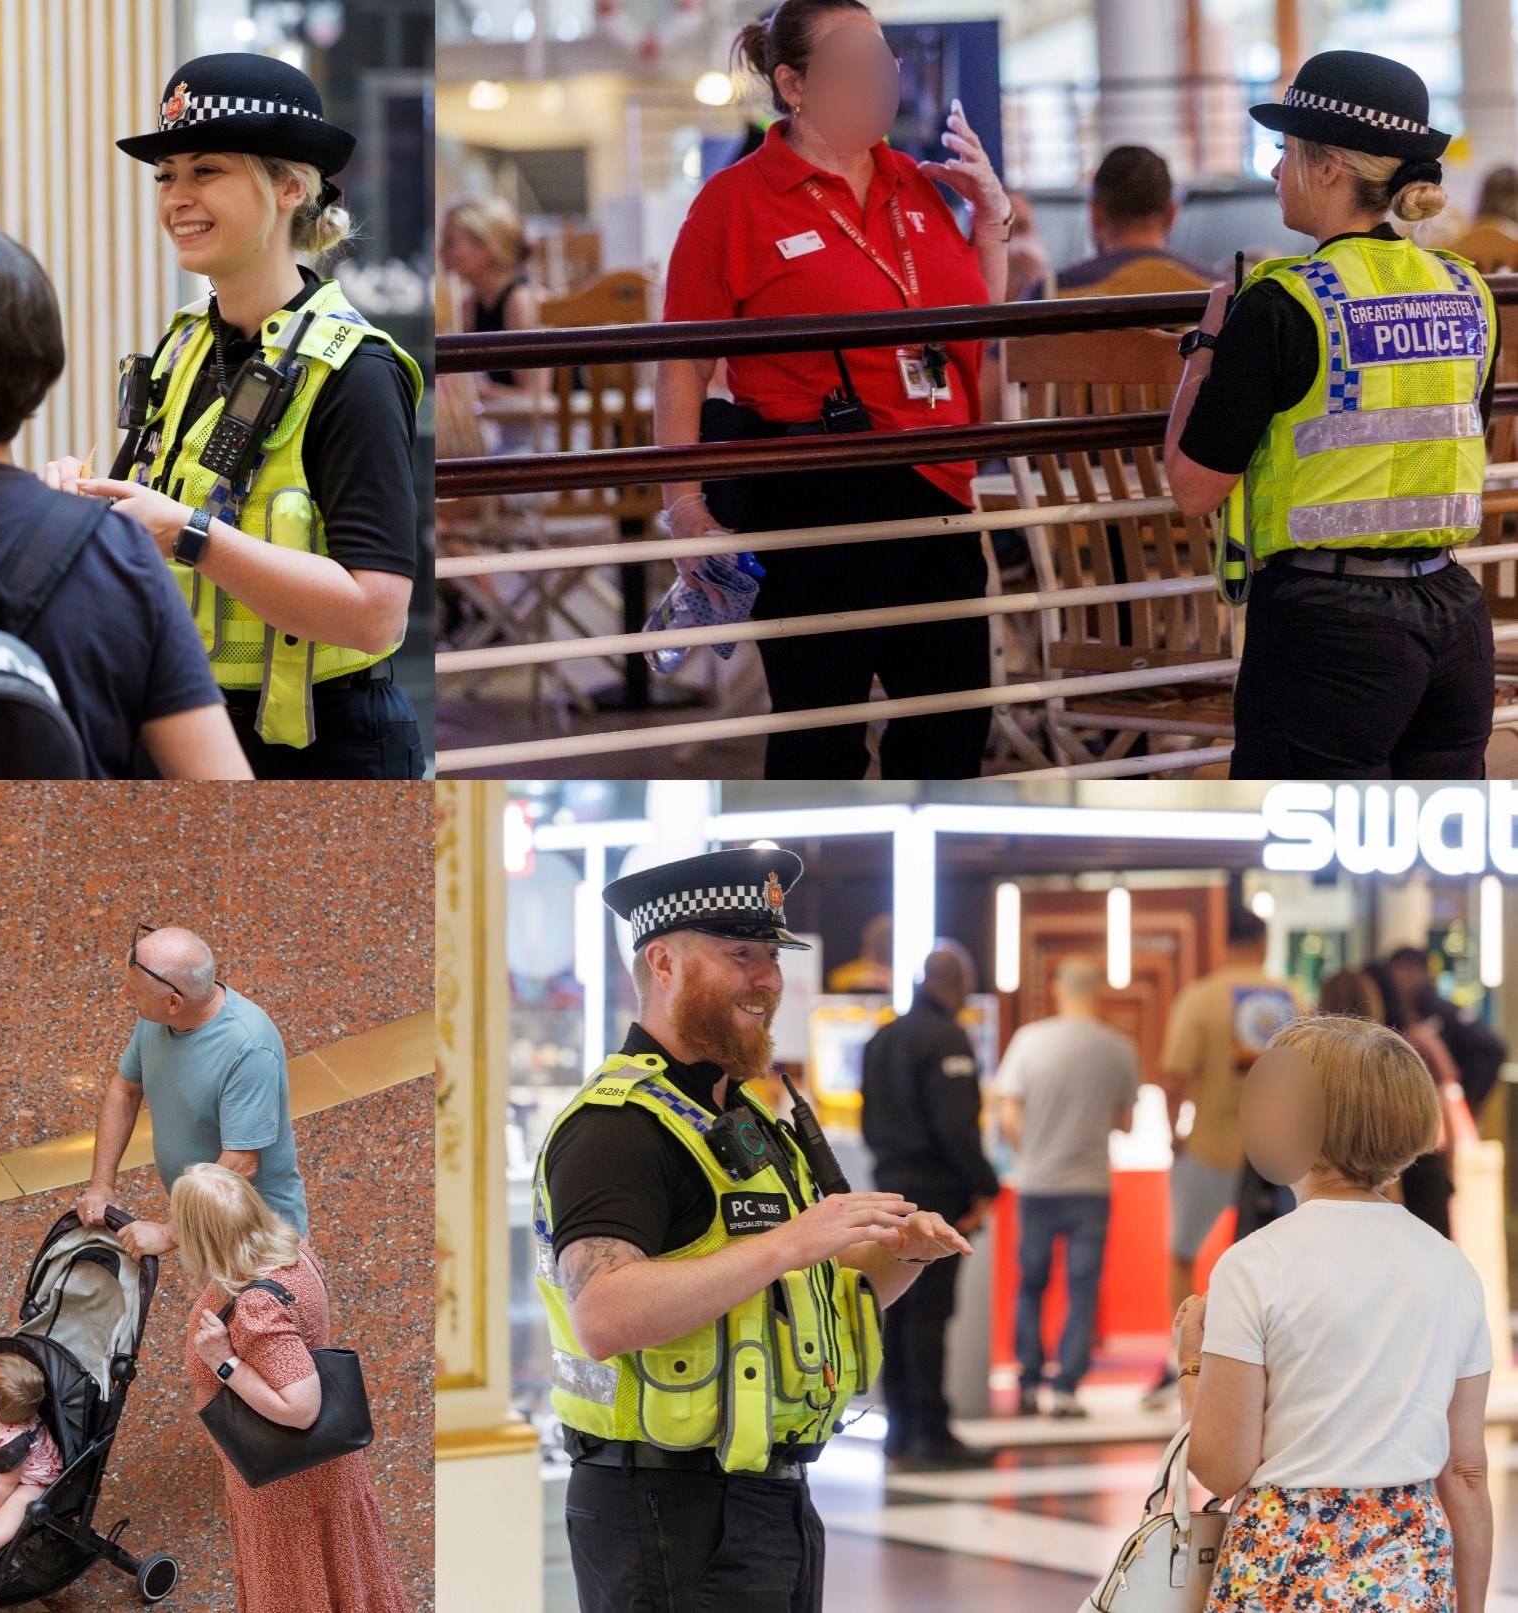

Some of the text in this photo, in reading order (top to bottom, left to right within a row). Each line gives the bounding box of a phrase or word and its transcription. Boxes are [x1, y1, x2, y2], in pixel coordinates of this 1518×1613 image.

[1350, 301, 1474, 324] GREATER MANCHESTER
[323, 325, 352, 358] 17282
[1374, 320, 1464, 355] POLICE
[1262, 780, 1518, 876] swat
[595, 1087, 627, 1097] 18285
[731, 1199, 781, 1217] PC 18285
[729, 1221, 763, 1230] SPECIALIST
